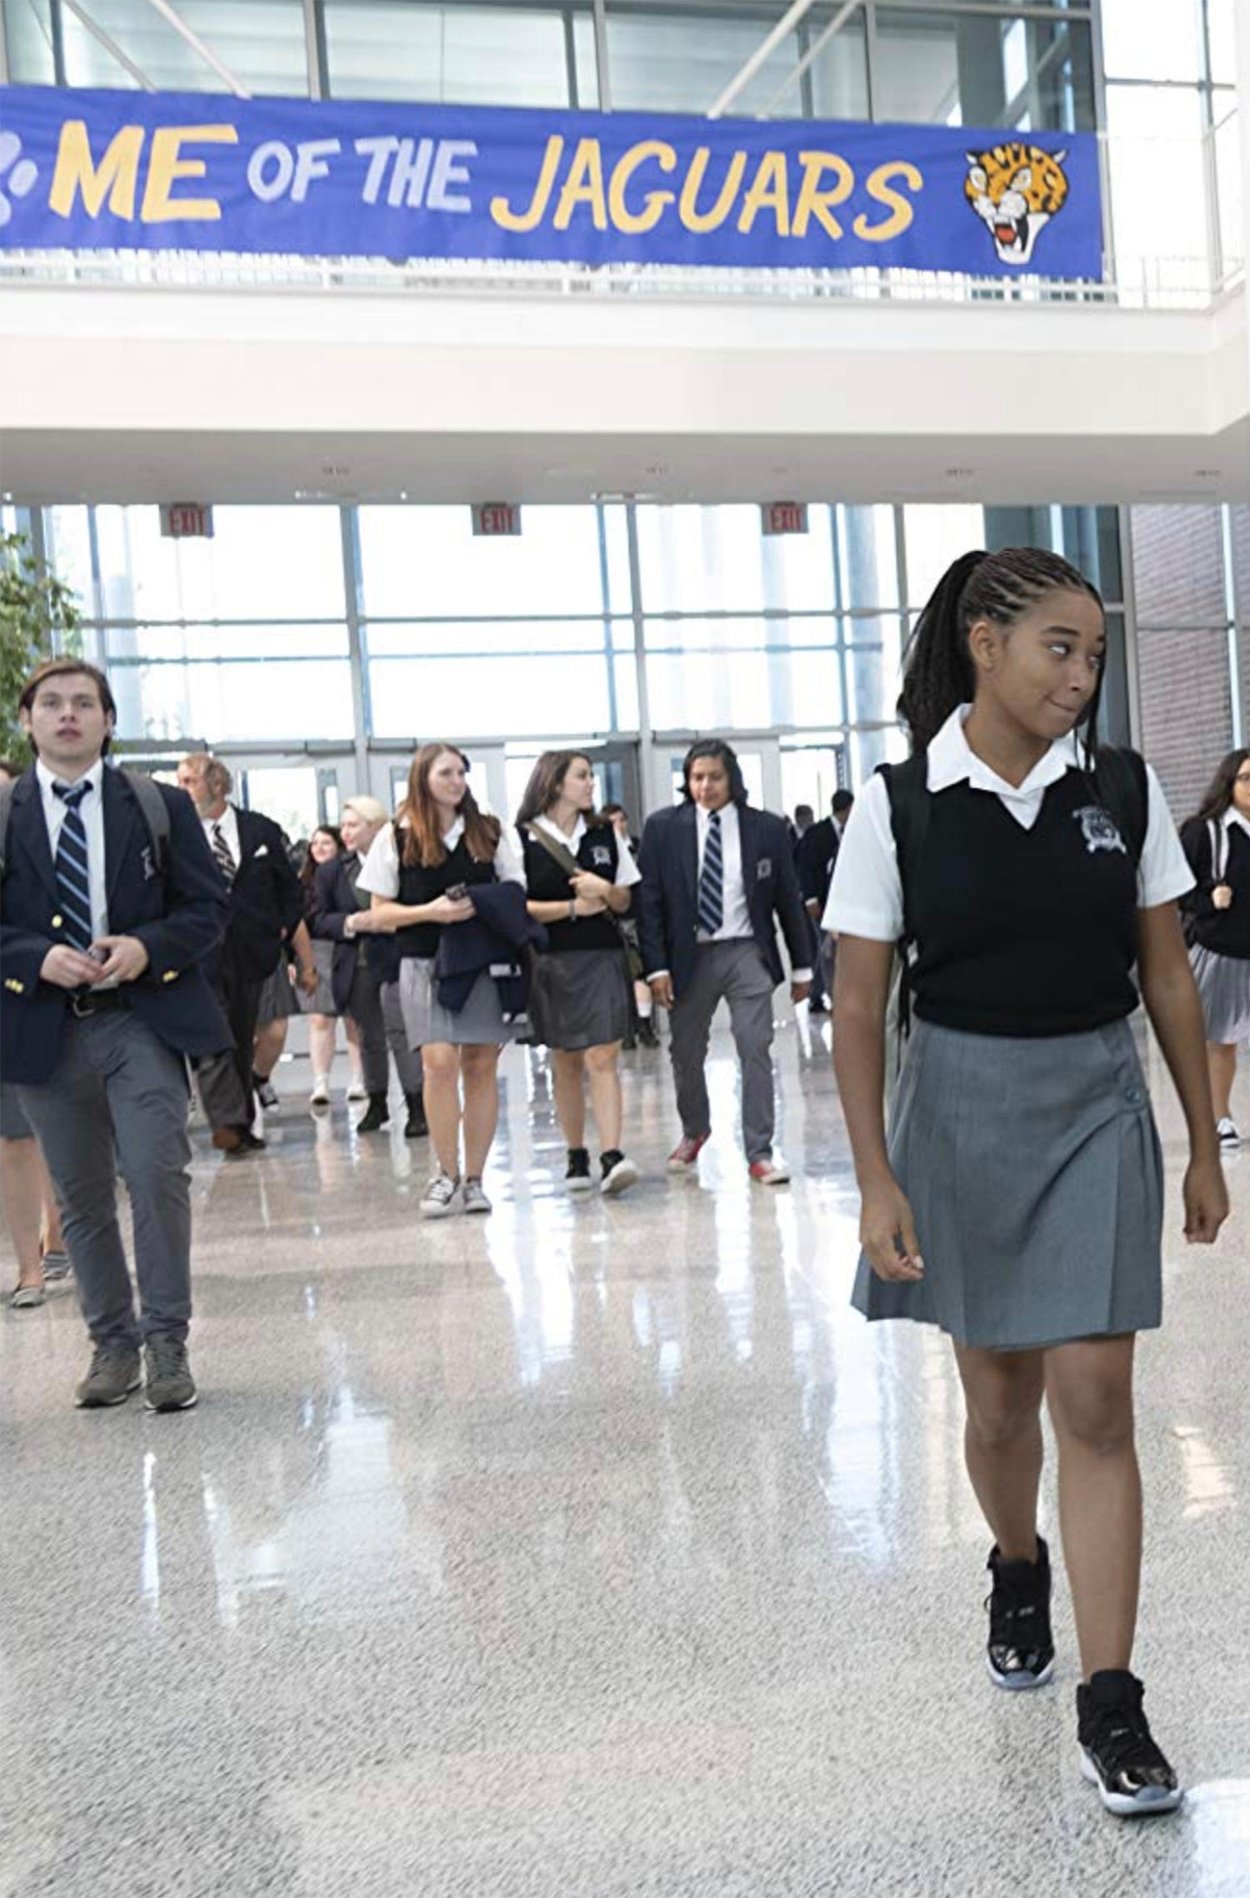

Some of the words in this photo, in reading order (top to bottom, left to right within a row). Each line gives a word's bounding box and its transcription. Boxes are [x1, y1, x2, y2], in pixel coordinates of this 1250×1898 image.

[248, 140, 340, 201] OF
[355, 138, 476, 210] THE
[490, 136, 922, 241] JAGUARS
[169, 508, 205, 534] EXIT
[481, 508, 513, 533] EXIT
[770, 507, 801, 531] EXIT
